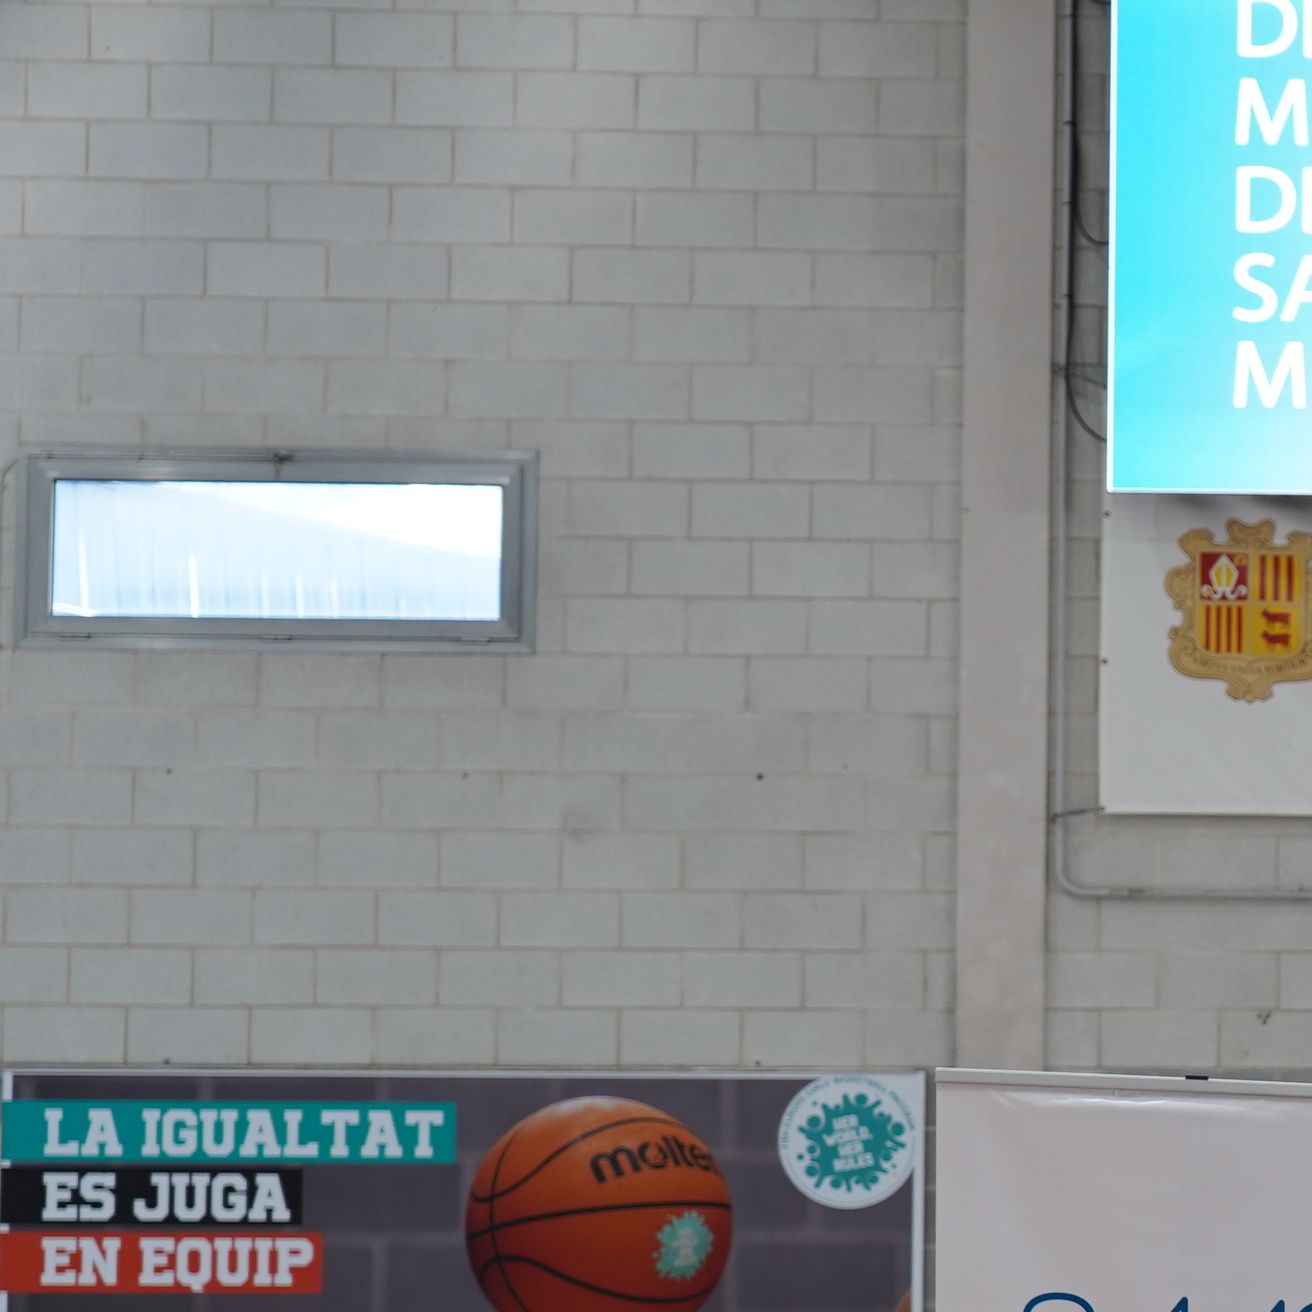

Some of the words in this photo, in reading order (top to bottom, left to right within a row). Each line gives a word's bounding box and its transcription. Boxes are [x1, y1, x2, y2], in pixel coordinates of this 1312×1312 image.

[42, 1107, 123, 1157] LA
[140, 1107, 445, 1158] IGUALTAT
[590, 1135, 718, 1183] molte
[41, 1171, 117, 1222] ES
[132, 1172, 292, 1222] JUGA
[40, 1236, 122, 1286] EN
[137, 1236, 315, 1293] EQUIP
